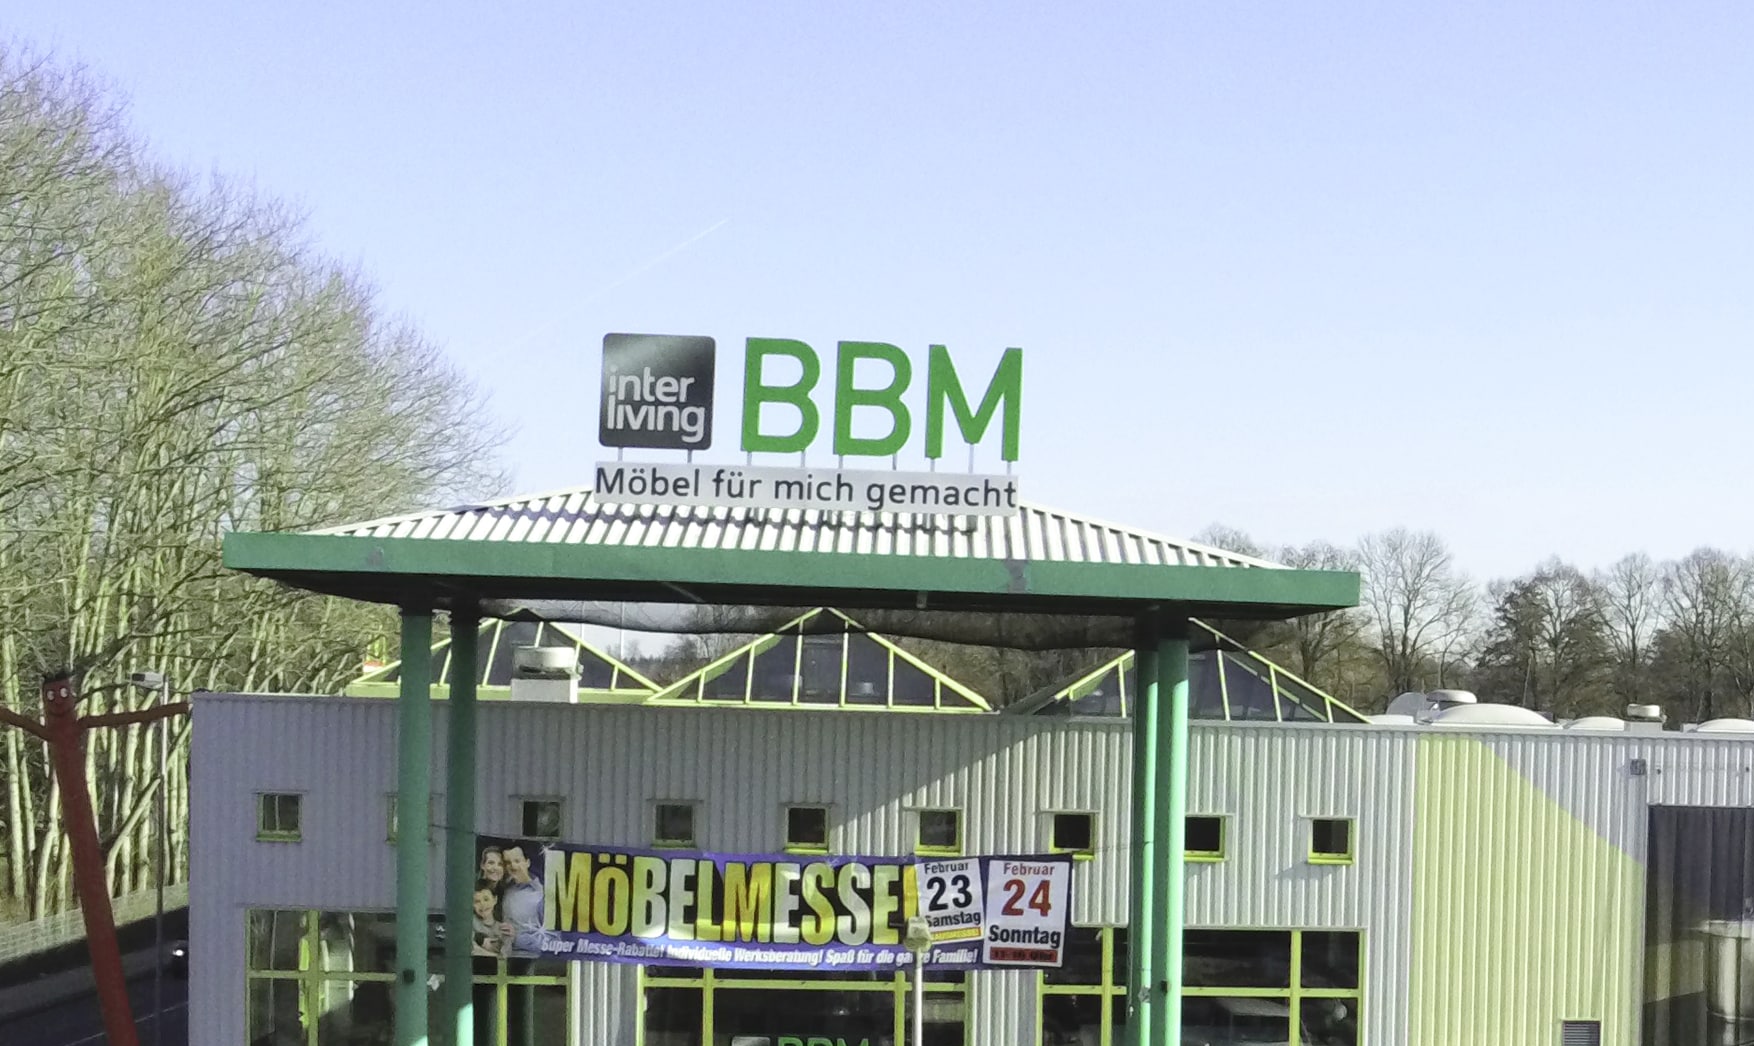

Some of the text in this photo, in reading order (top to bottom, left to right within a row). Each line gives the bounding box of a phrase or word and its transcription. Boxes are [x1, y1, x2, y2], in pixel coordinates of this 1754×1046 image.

[608, 363, 694, 403] inter
[741, 337, 1023, 462] BBM
[607, 400, 705, 443] living
[595, 467, 1017, 511] Möbel für mich gemacht
[924, 861, 969, 875] Februar
[1003, 863, 1055, 875] Februar
[926, 875, 973, 912] 23
[1001, 879, 1052, 917] 24
[926, 911, 982, 928] Samstag
[988, 924, 1061, 949] Sonntag
[541, 937, 575, 956] Super
[826, 949, 854, 965] Spaß
[858, 949, 874, 964] für
[876, 949, 894, 964] die
